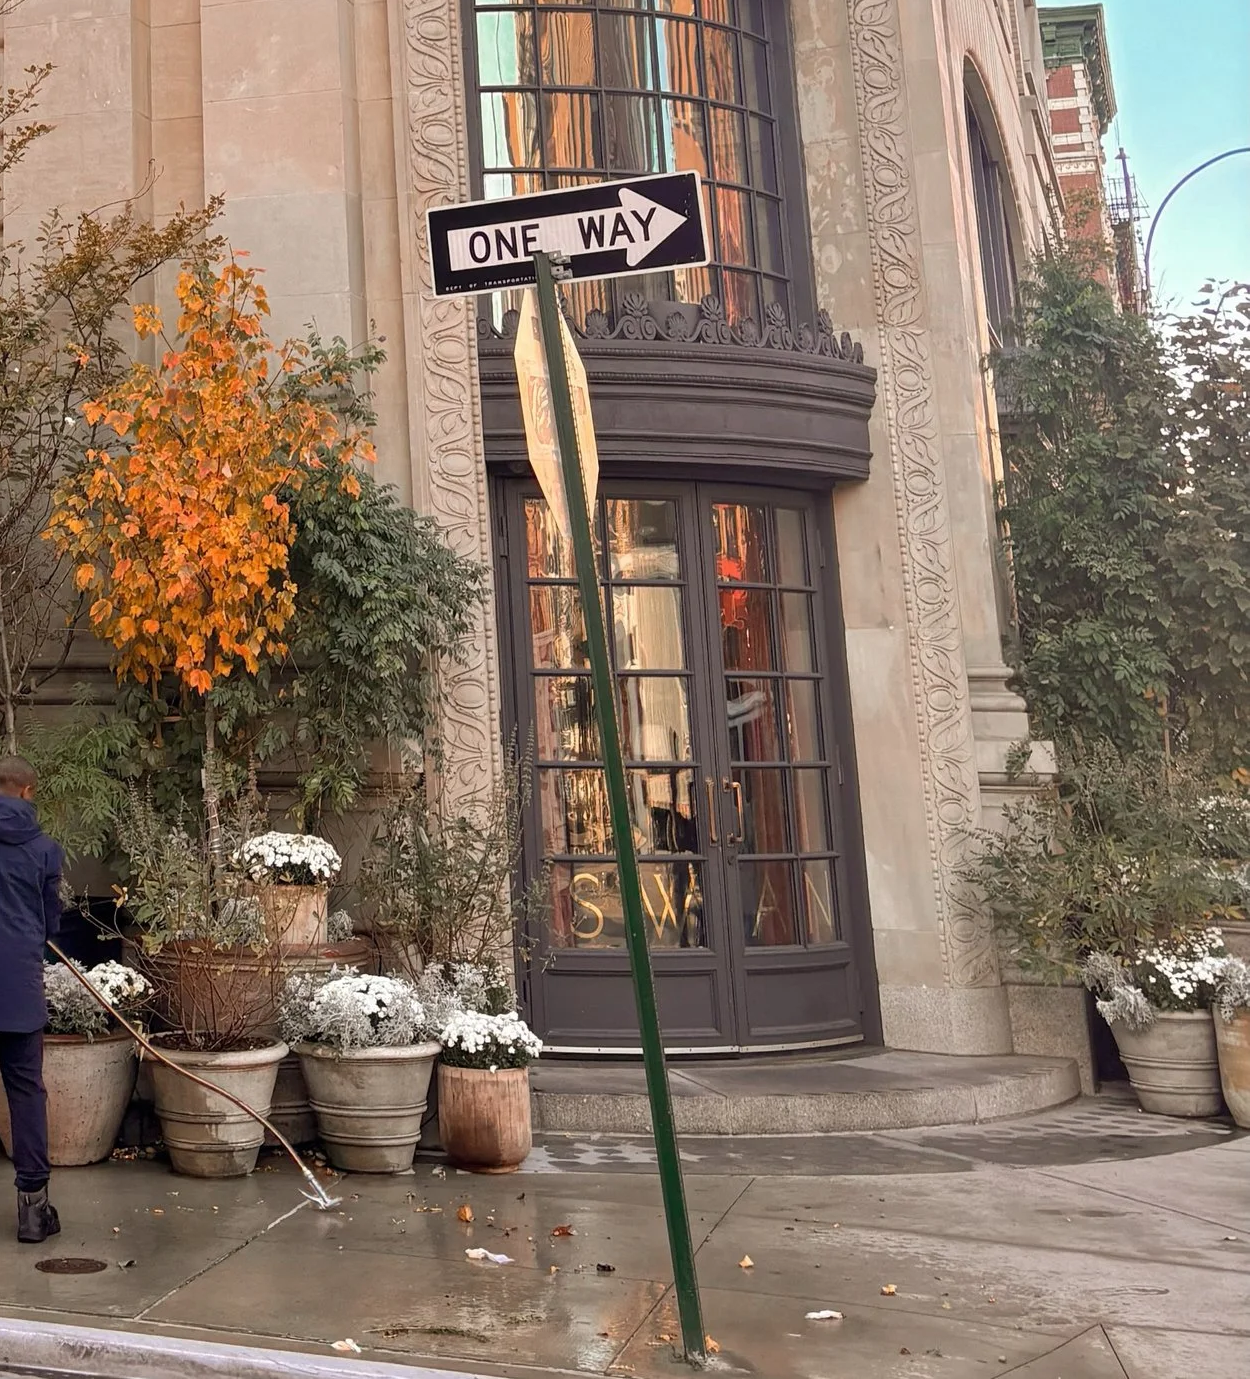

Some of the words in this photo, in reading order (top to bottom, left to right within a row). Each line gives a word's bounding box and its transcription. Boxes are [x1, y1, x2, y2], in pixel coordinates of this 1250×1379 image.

[469, 223, 540, 263] ONE
[577, 207, 657, 249] WAY
[484, 275, 537, 286] TRANSPORTATI
